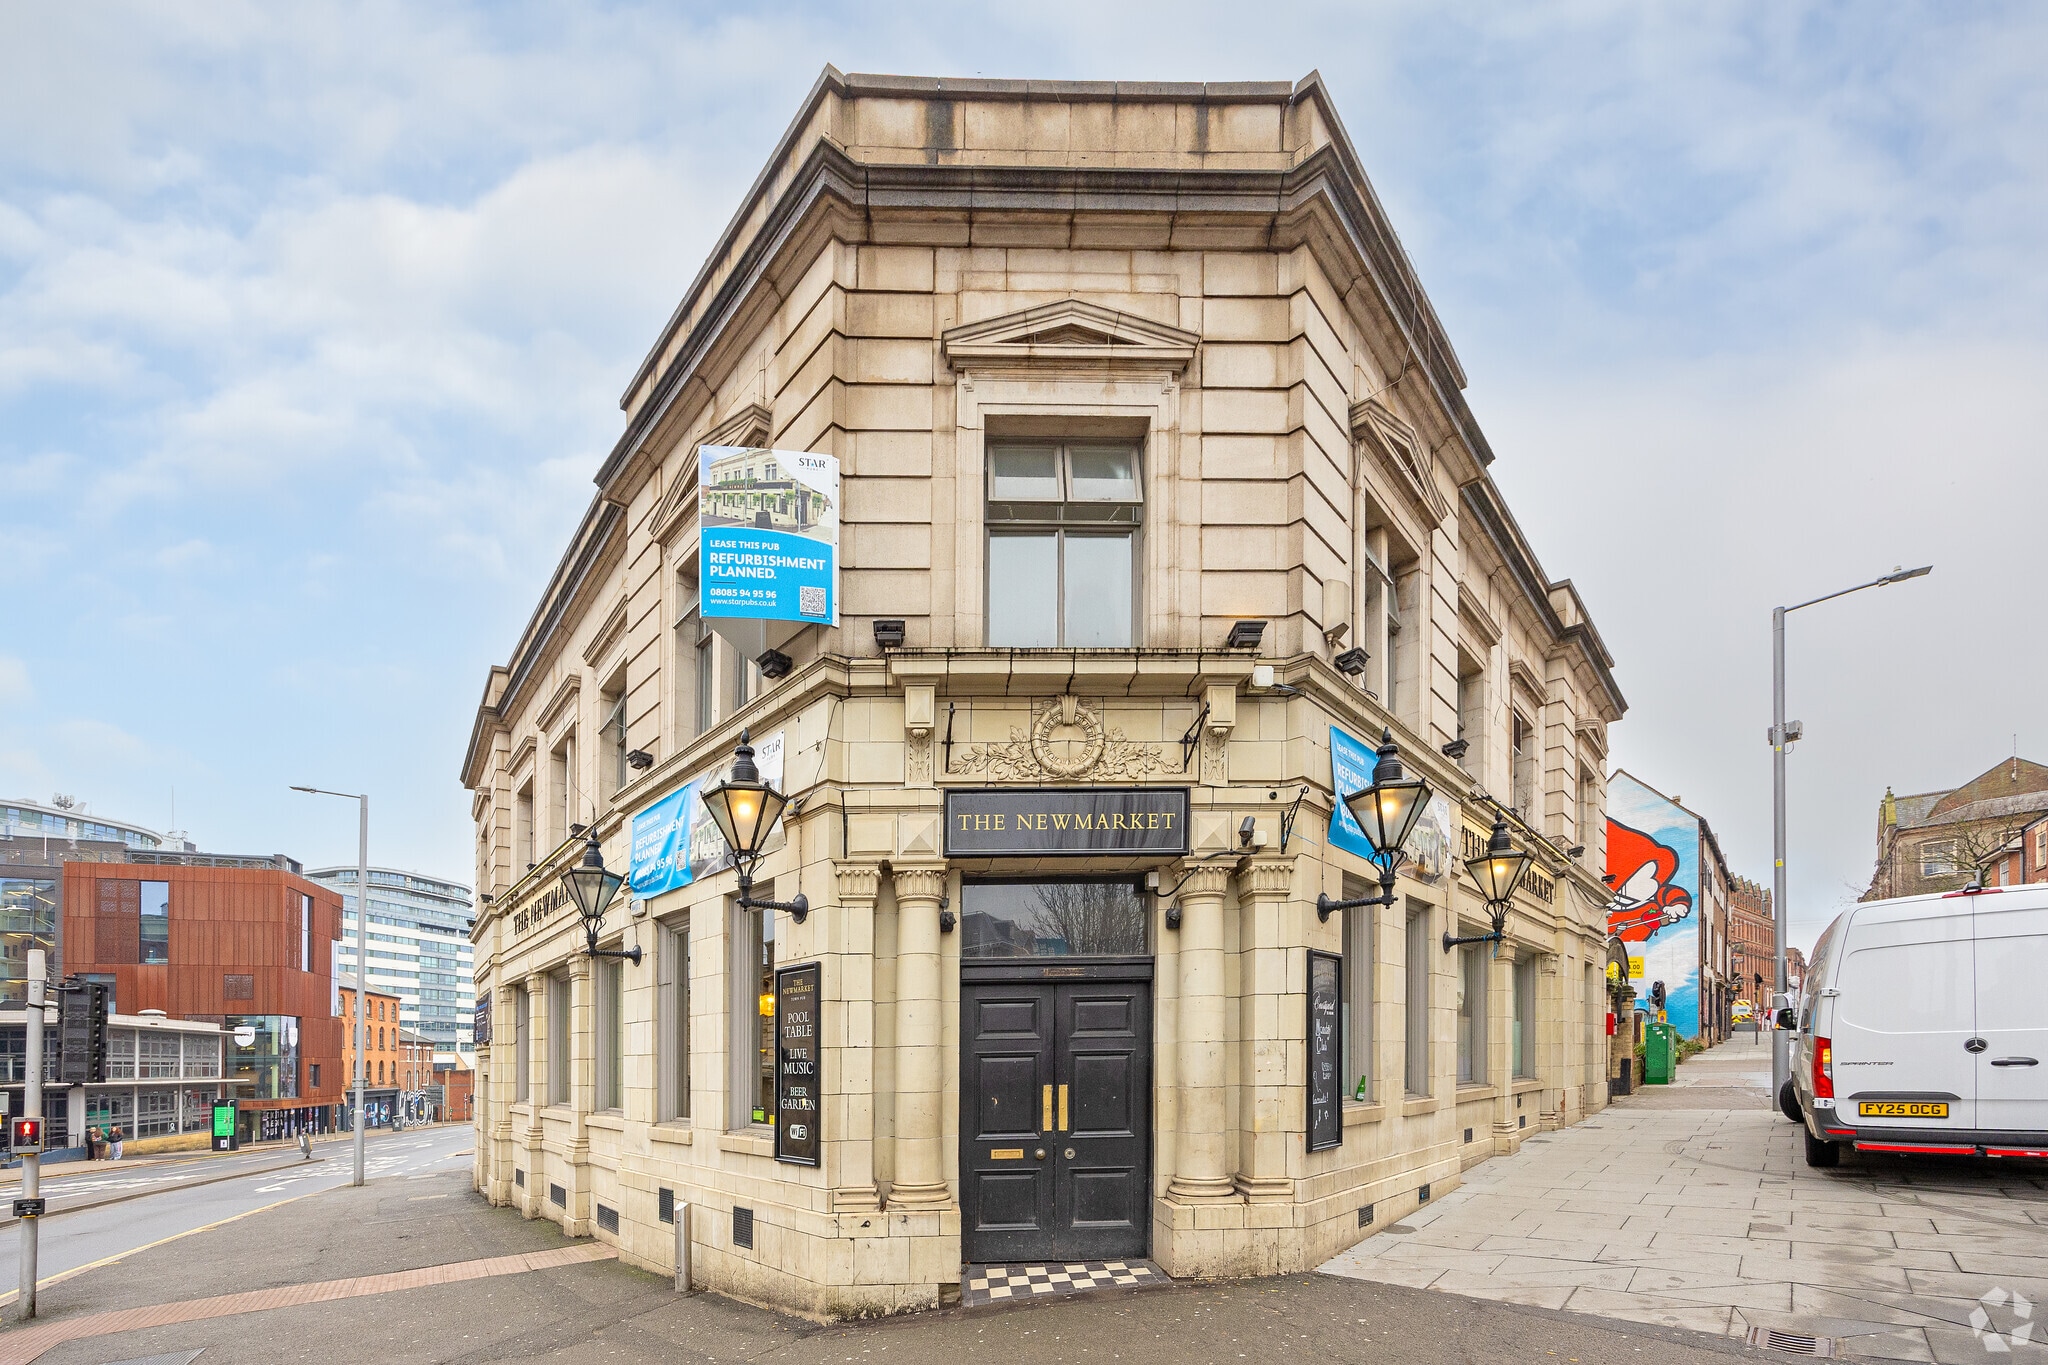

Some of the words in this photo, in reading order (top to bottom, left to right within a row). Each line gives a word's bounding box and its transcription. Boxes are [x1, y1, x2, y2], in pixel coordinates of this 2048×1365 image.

[799, 457, 826, 469] STAR
[709, 539, 737, 549] LEASE
[738, 541, 760, 550] THIS
[761, 542, 780, 551] PUB
[709, 552, 826, 571] REFURBISHMENT
[709, 565, 777, 580] PLANNED.
[709, 587, 738, 597] 08085
[739, 589, 751, 598] 94
[752, 590, 764, 598] 95
[765, 590, 777, 599] 96
[709, 598, 777, 607] www.starpubs.co.uk
[761, 739, 781, 760] STAR
[1336, 743, 1349, 756] LEASE
[1337, 762, 1373, 790] REFURBIS
[957, 814, 1006, 831] THE
[1016, 812, 1176, 831] NEWMARKET
[635, 815, 685, 851] REFURBISHMENT
[656, 858, 665, 870] 95
[665, 854, 673, 867] 96
[1518, 867, 1554, 905] ARKET
[513, 908, 530, 935] THE
[530, 881, 573, 926] NEWMA
[793, 978, 803, 987] THE
[782, 984, 815, 995] NEWMARKET
[787, 1011, 810, 1024] POOL
[784, 1024, 813, 1038] TABLE
[789, 1048, 808, 1060] LIVE
[783, 1061, 814, 1075] MUSIC
[789, 1086, 808, 1097] BEER
[781, 1098, 816, 1111] GARDEN
[1865, 1104, 1906, 1115] FY25
[1910, 1104, 1941, 1115] OCG
